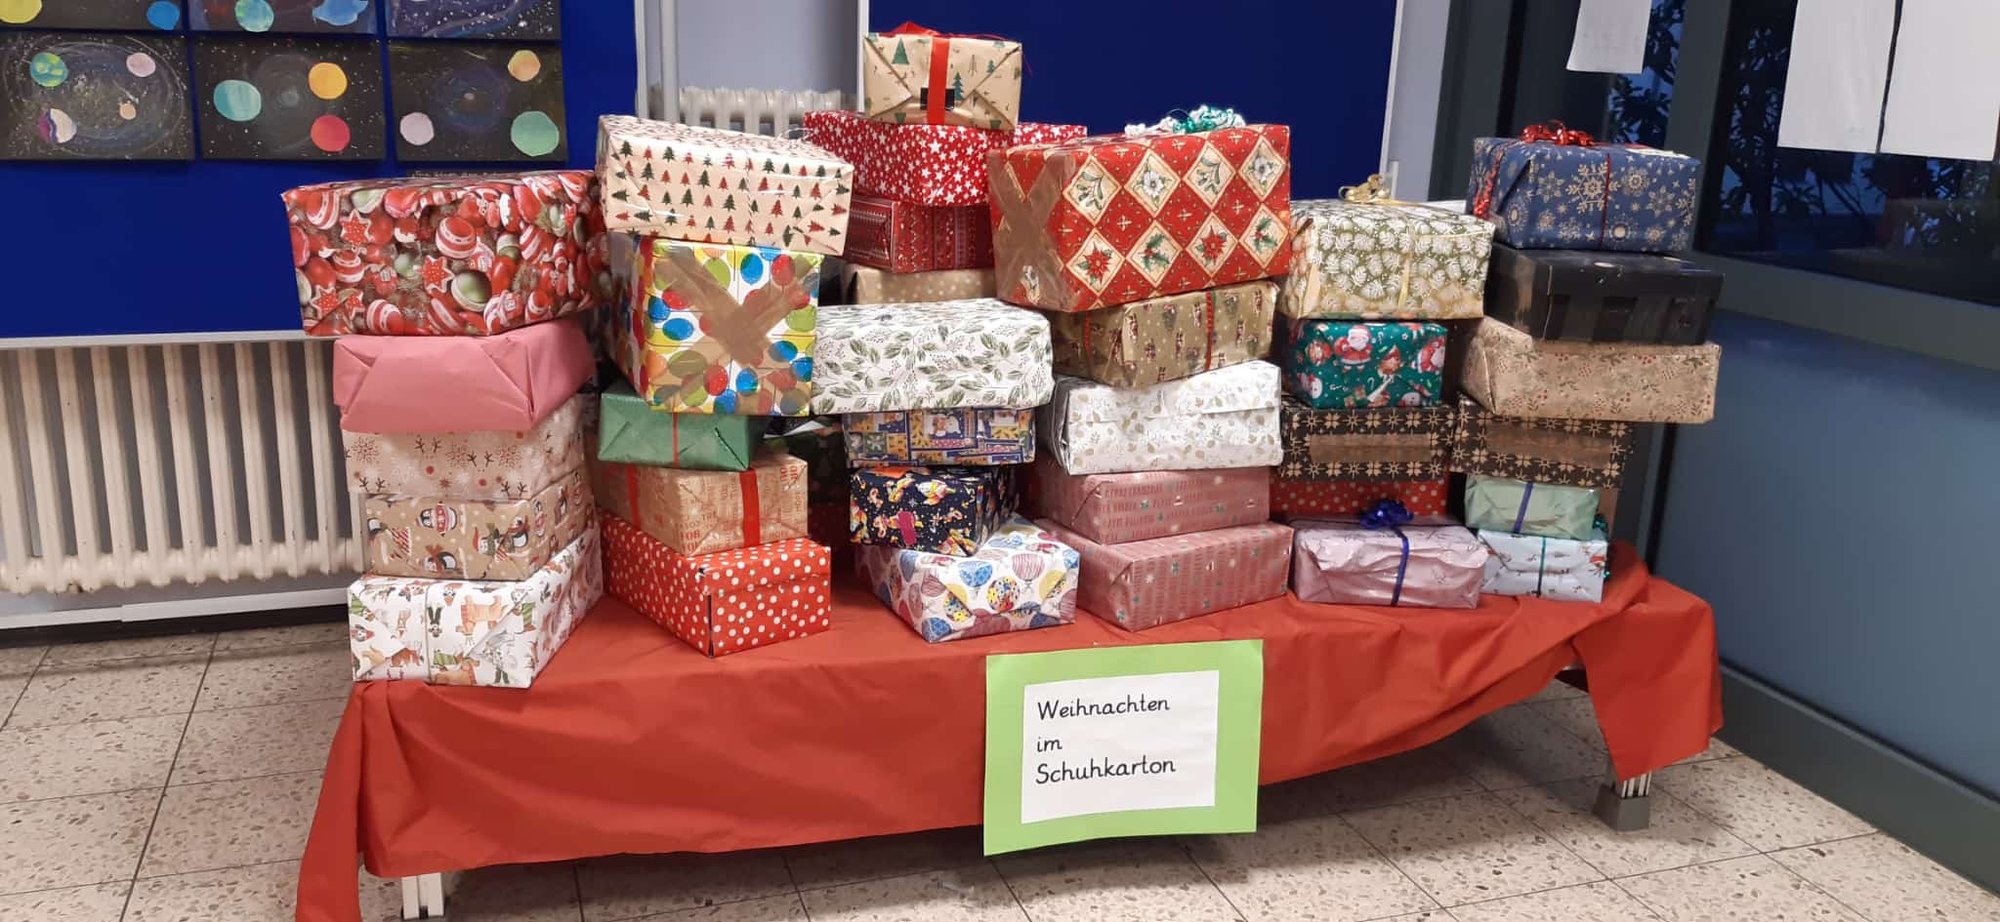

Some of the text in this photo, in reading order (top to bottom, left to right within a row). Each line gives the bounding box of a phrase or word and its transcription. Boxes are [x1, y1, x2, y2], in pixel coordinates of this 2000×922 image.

[1037, 693, 1170, 721] Weihnachten
[1036, 736, 1063, 753] im
[1035, 755, 1176, 785] Schuhkarton
